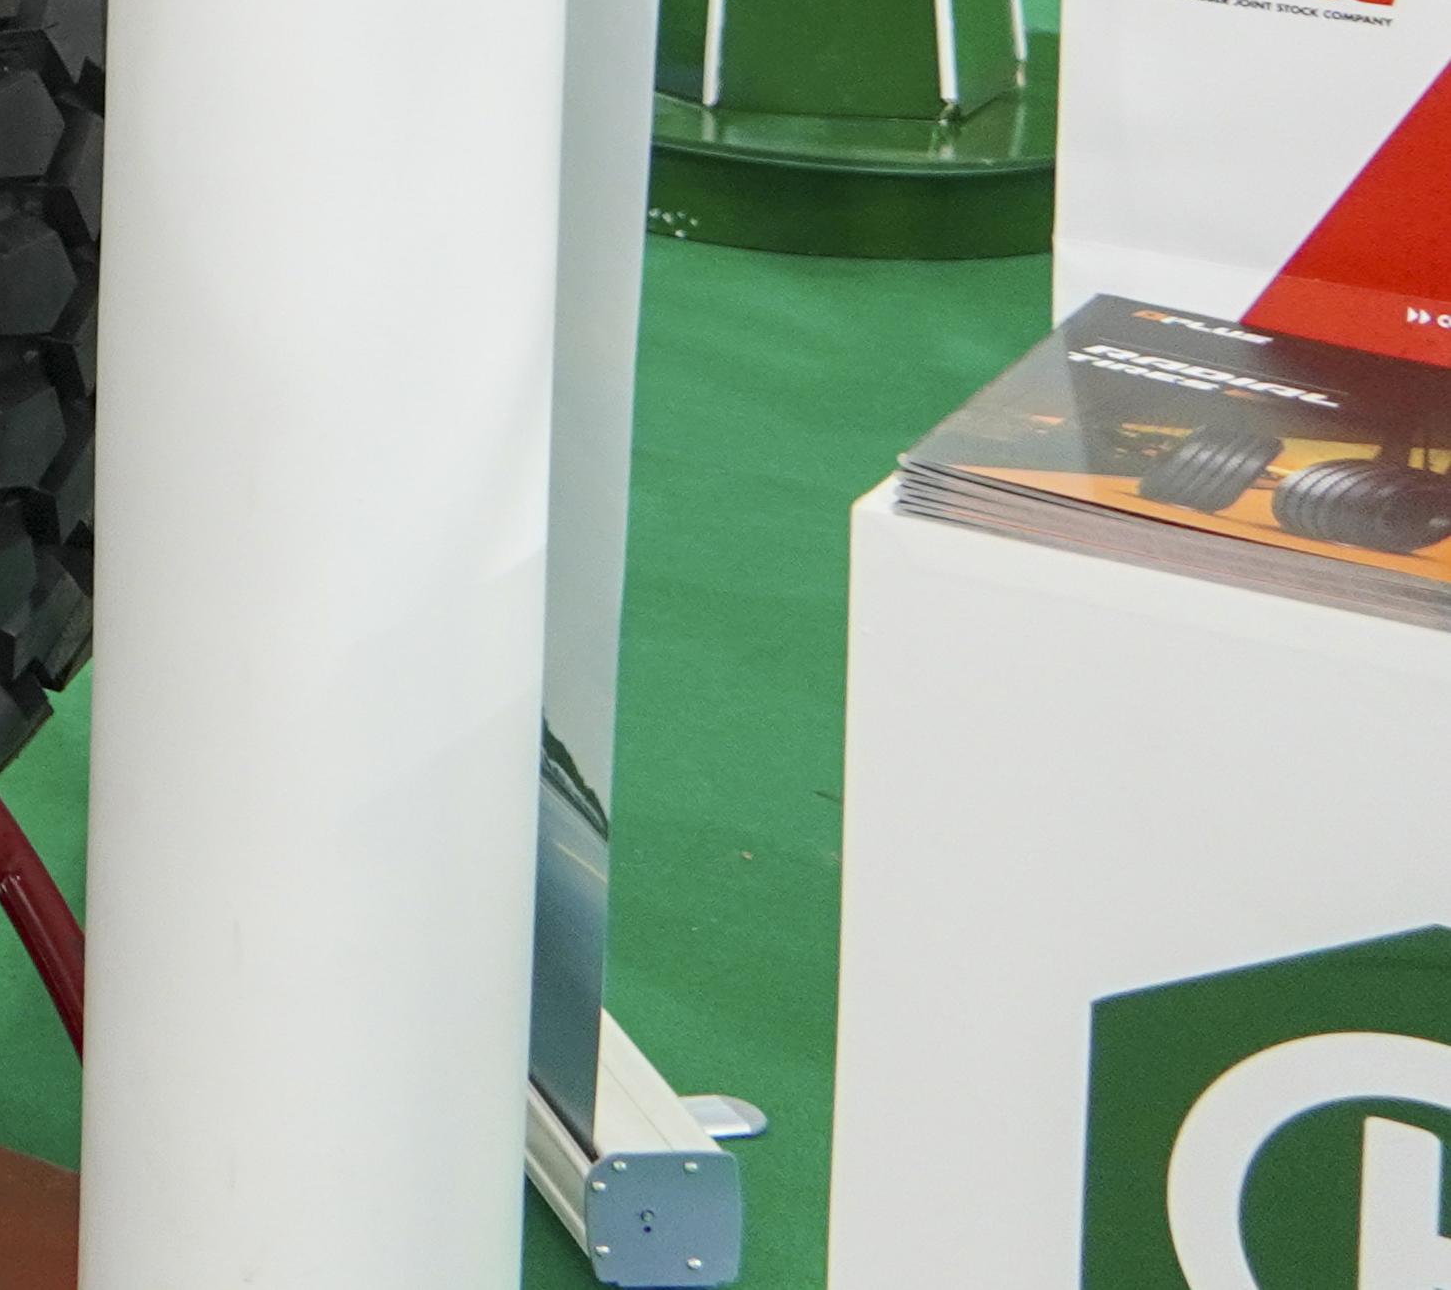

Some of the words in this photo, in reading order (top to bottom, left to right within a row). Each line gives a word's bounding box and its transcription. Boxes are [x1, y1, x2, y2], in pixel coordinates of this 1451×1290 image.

[1276, 3, 1319, 18] STOCK
[1323, 9, 1393, 27] COMPANY
[1067, 351, 1220, 391] TIRES
[1084, 344, 1340, 409] RADIAL
